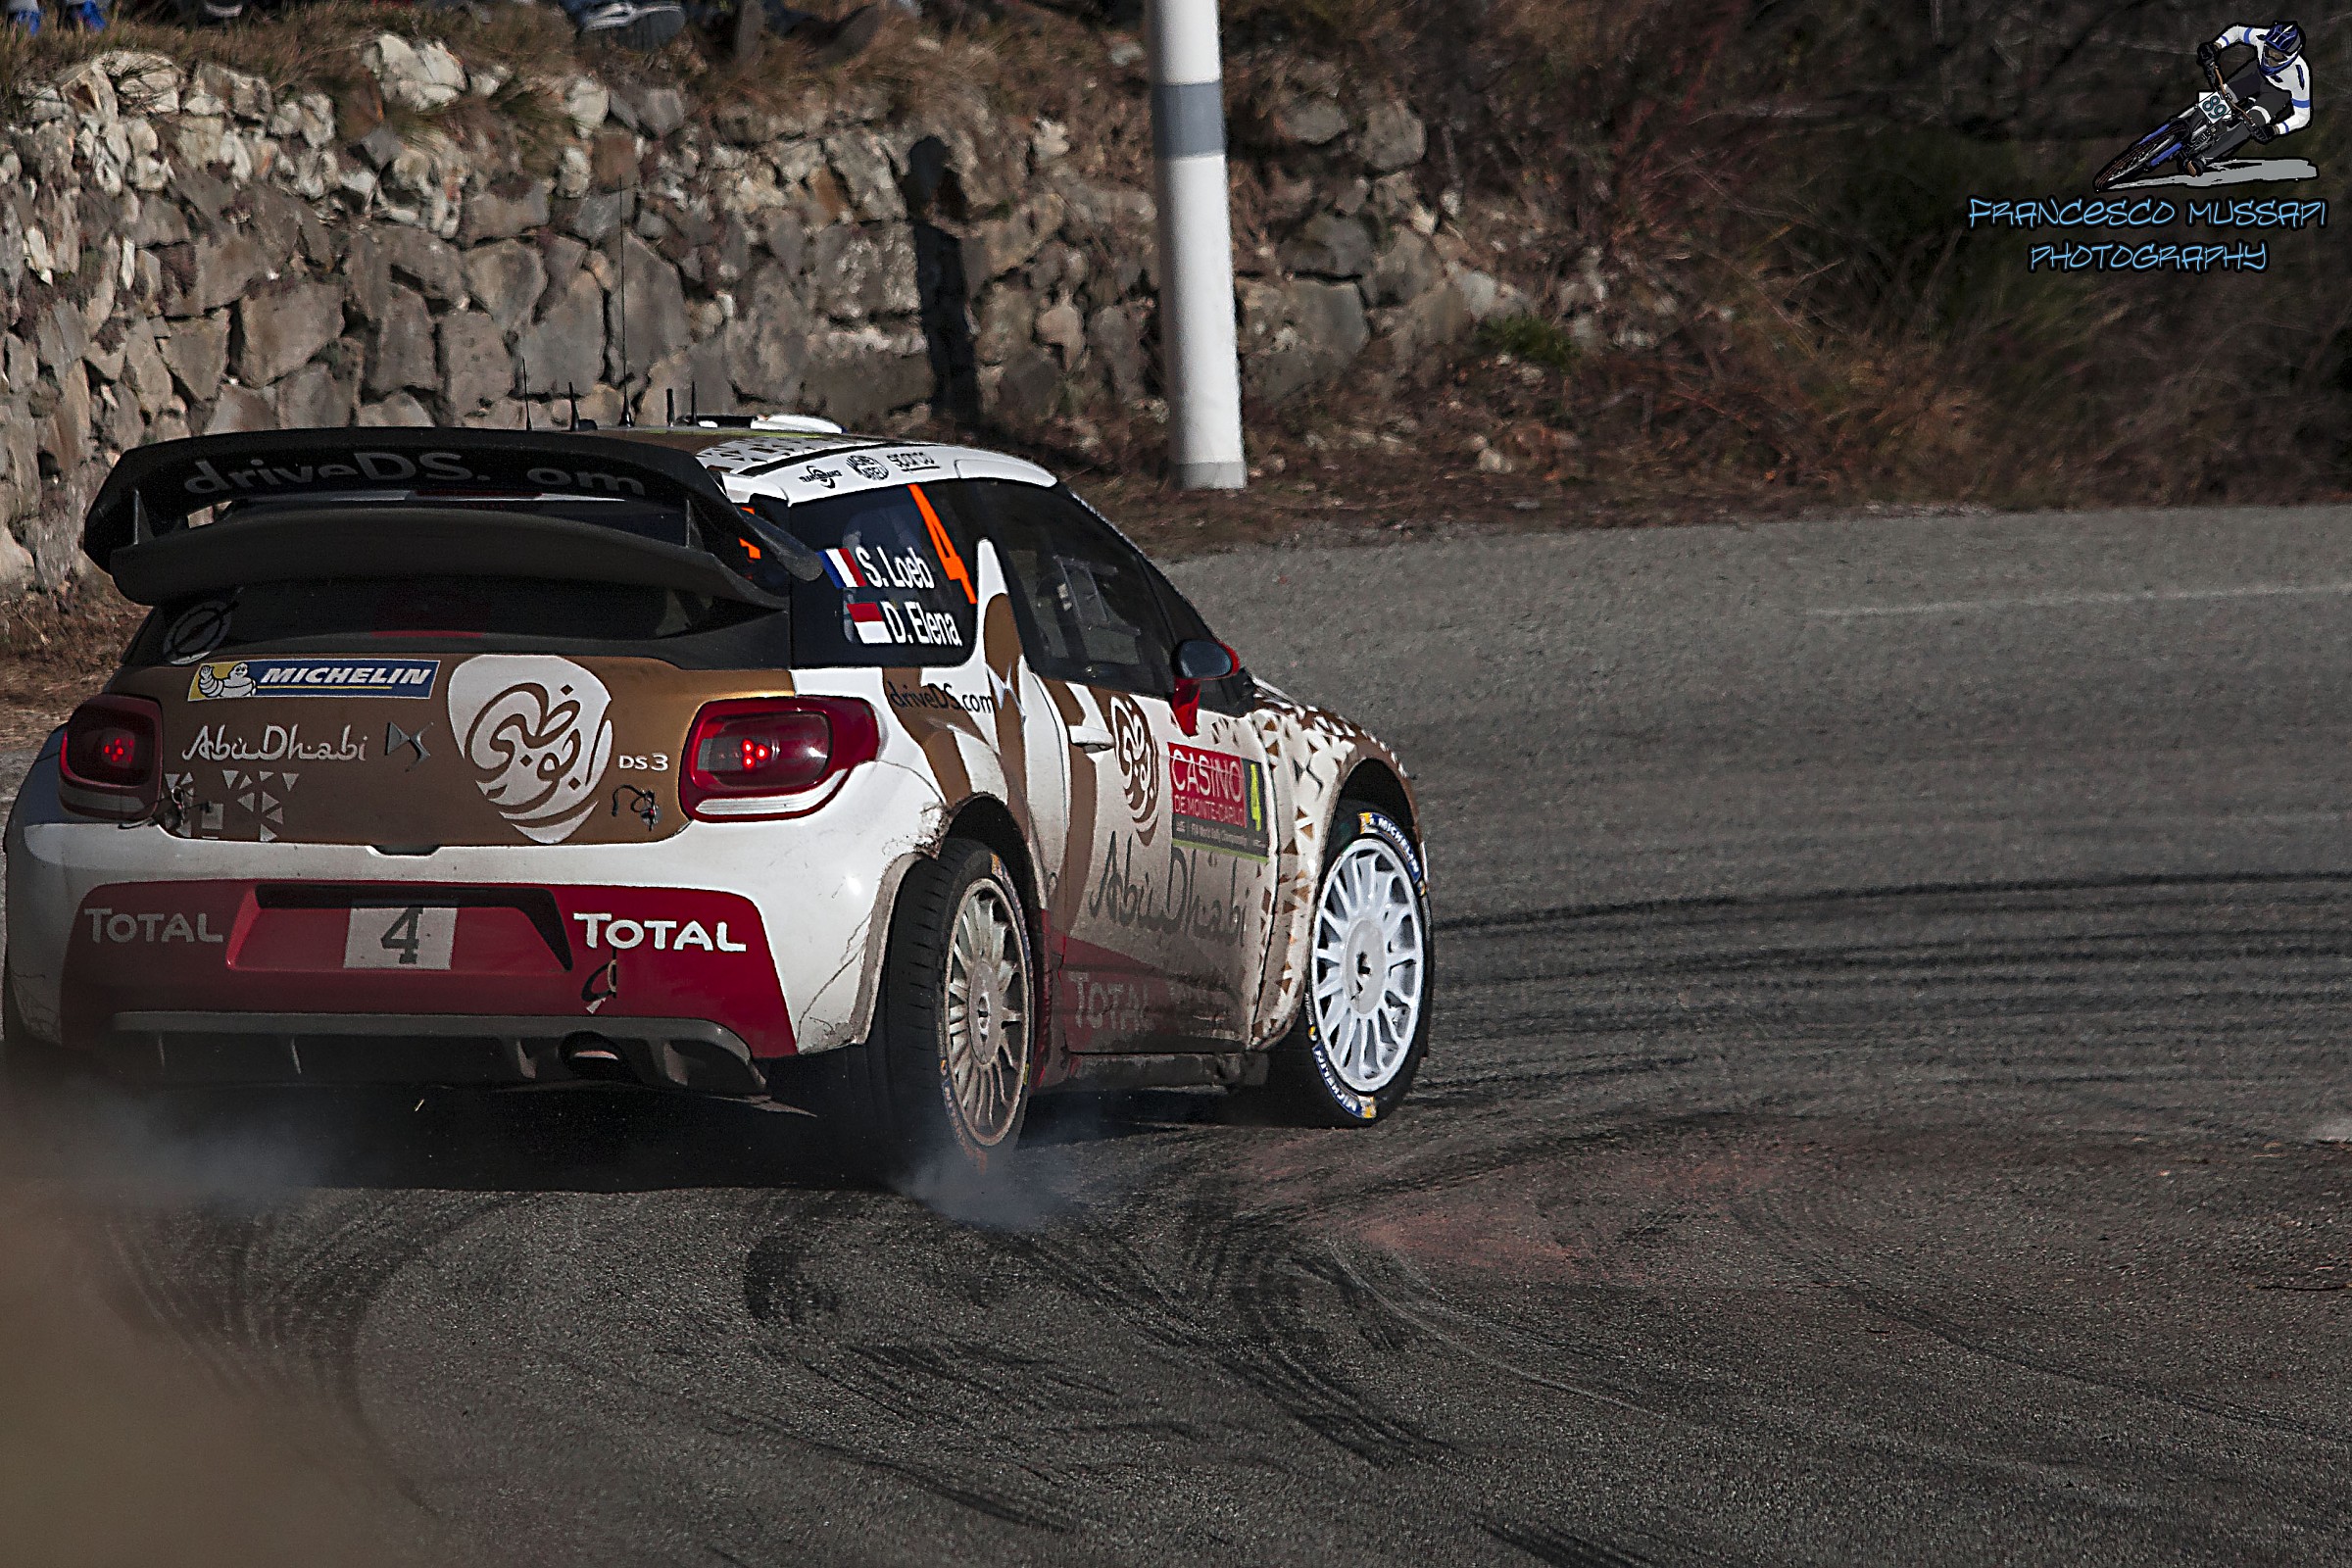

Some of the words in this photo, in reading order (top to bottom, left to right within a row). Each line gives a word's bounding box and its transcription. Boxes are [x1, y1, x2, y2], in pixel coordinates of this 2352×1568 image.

[183, 452, 645, 495] driveDS.om
[907, 483, 978, 605] 4
[856, 546, 887, 588] S.
[882, 549, 935, 589] Loeb
[882, 601, 912, 644] D.
[907, 602, 963, 647] Elena
[260, 665, 432, 685] MICHELIN
[1171, 749, 1244, 803] CASINO
[85, 907, 223, 945] TOTAL
[379, 907, 423, 964] 4
[573, 911, 747, 953] TOTAL
